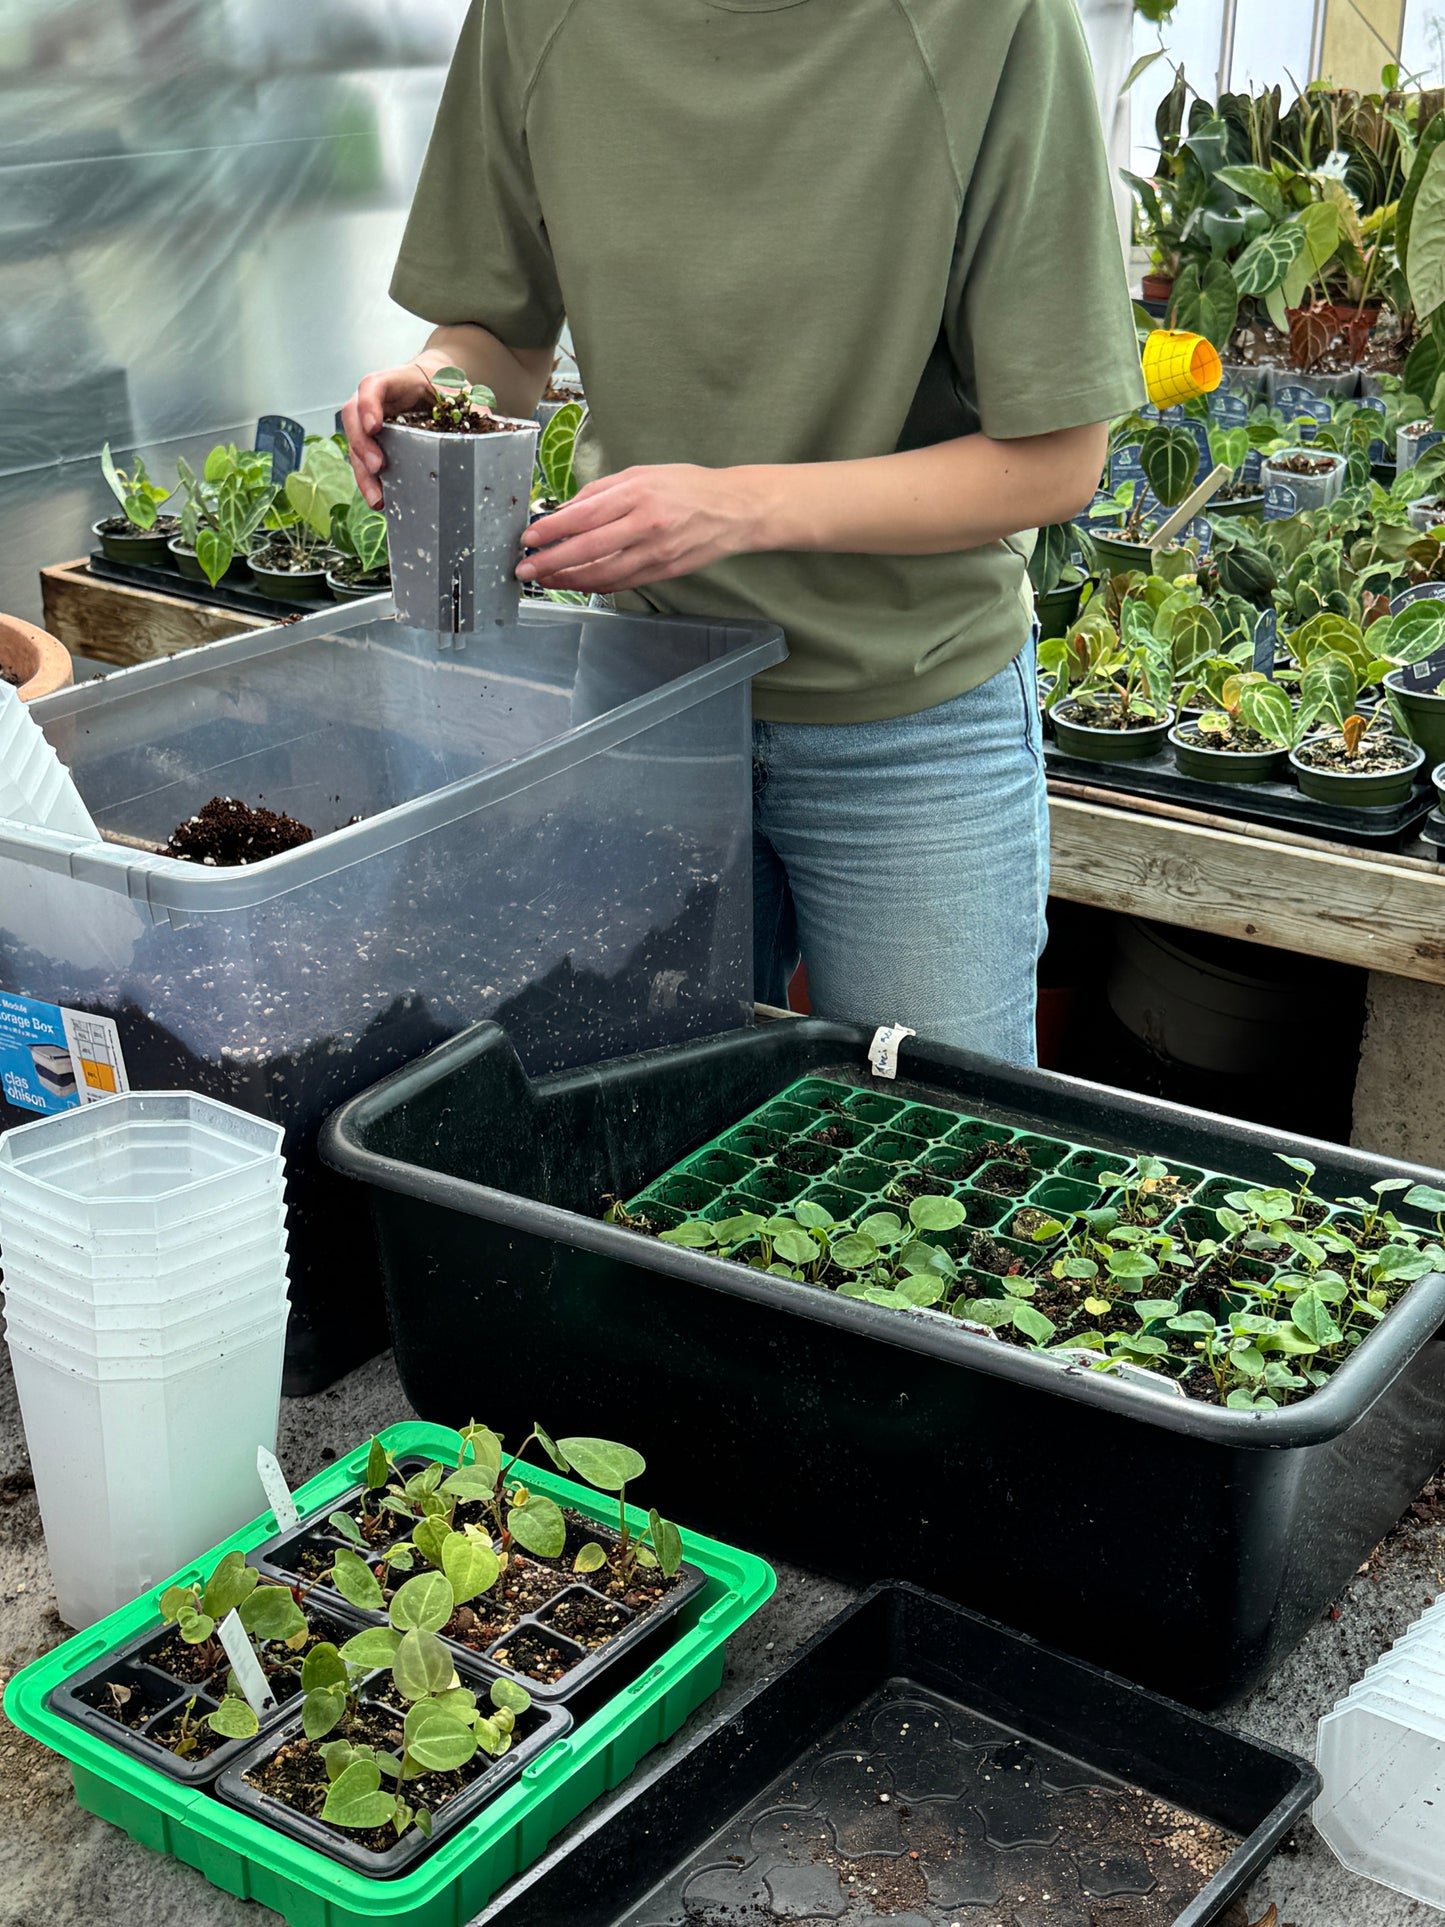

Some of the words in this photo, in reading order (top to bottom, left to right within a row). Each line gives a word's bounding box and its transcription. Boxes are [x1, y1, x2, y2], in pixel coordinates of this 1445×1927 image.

[0, 1012, 30, 1028] orage
[32, 1018, 54, 1034] Box
[5, 1071, 29, 1089] clas
[8, 1086, 46, 1108] ohlson
